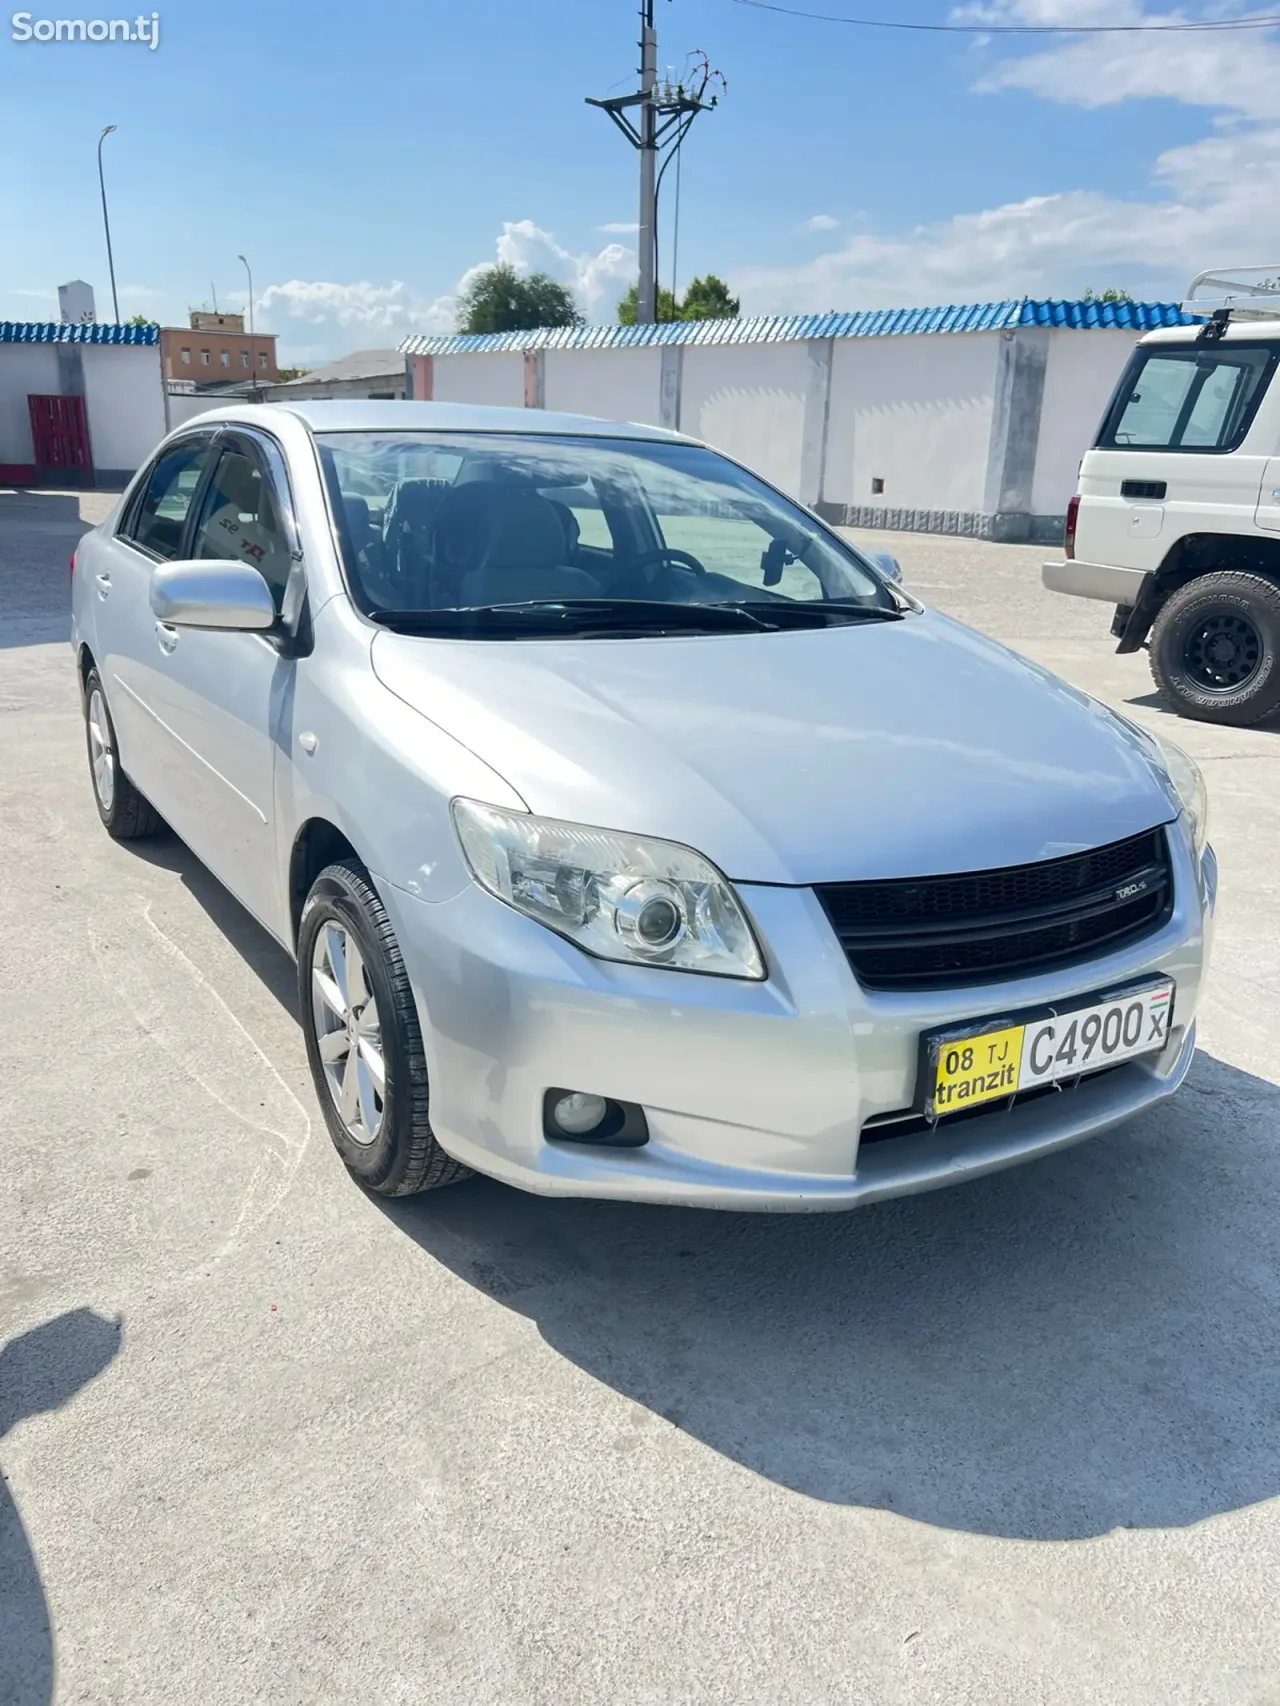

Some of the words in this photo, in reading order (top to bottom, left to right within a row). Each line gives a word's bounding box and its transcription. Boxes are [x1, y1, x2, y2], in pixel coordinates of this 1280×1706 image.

[945, 1046, 975, 1076] 08
[988, 1041, 1009, 1064] TJ
[1029, 1001, 1144, 1076] C4900
[1147, 1011, 1166, 1041] X
[936, 1063, 1015, 1105] tranzit
